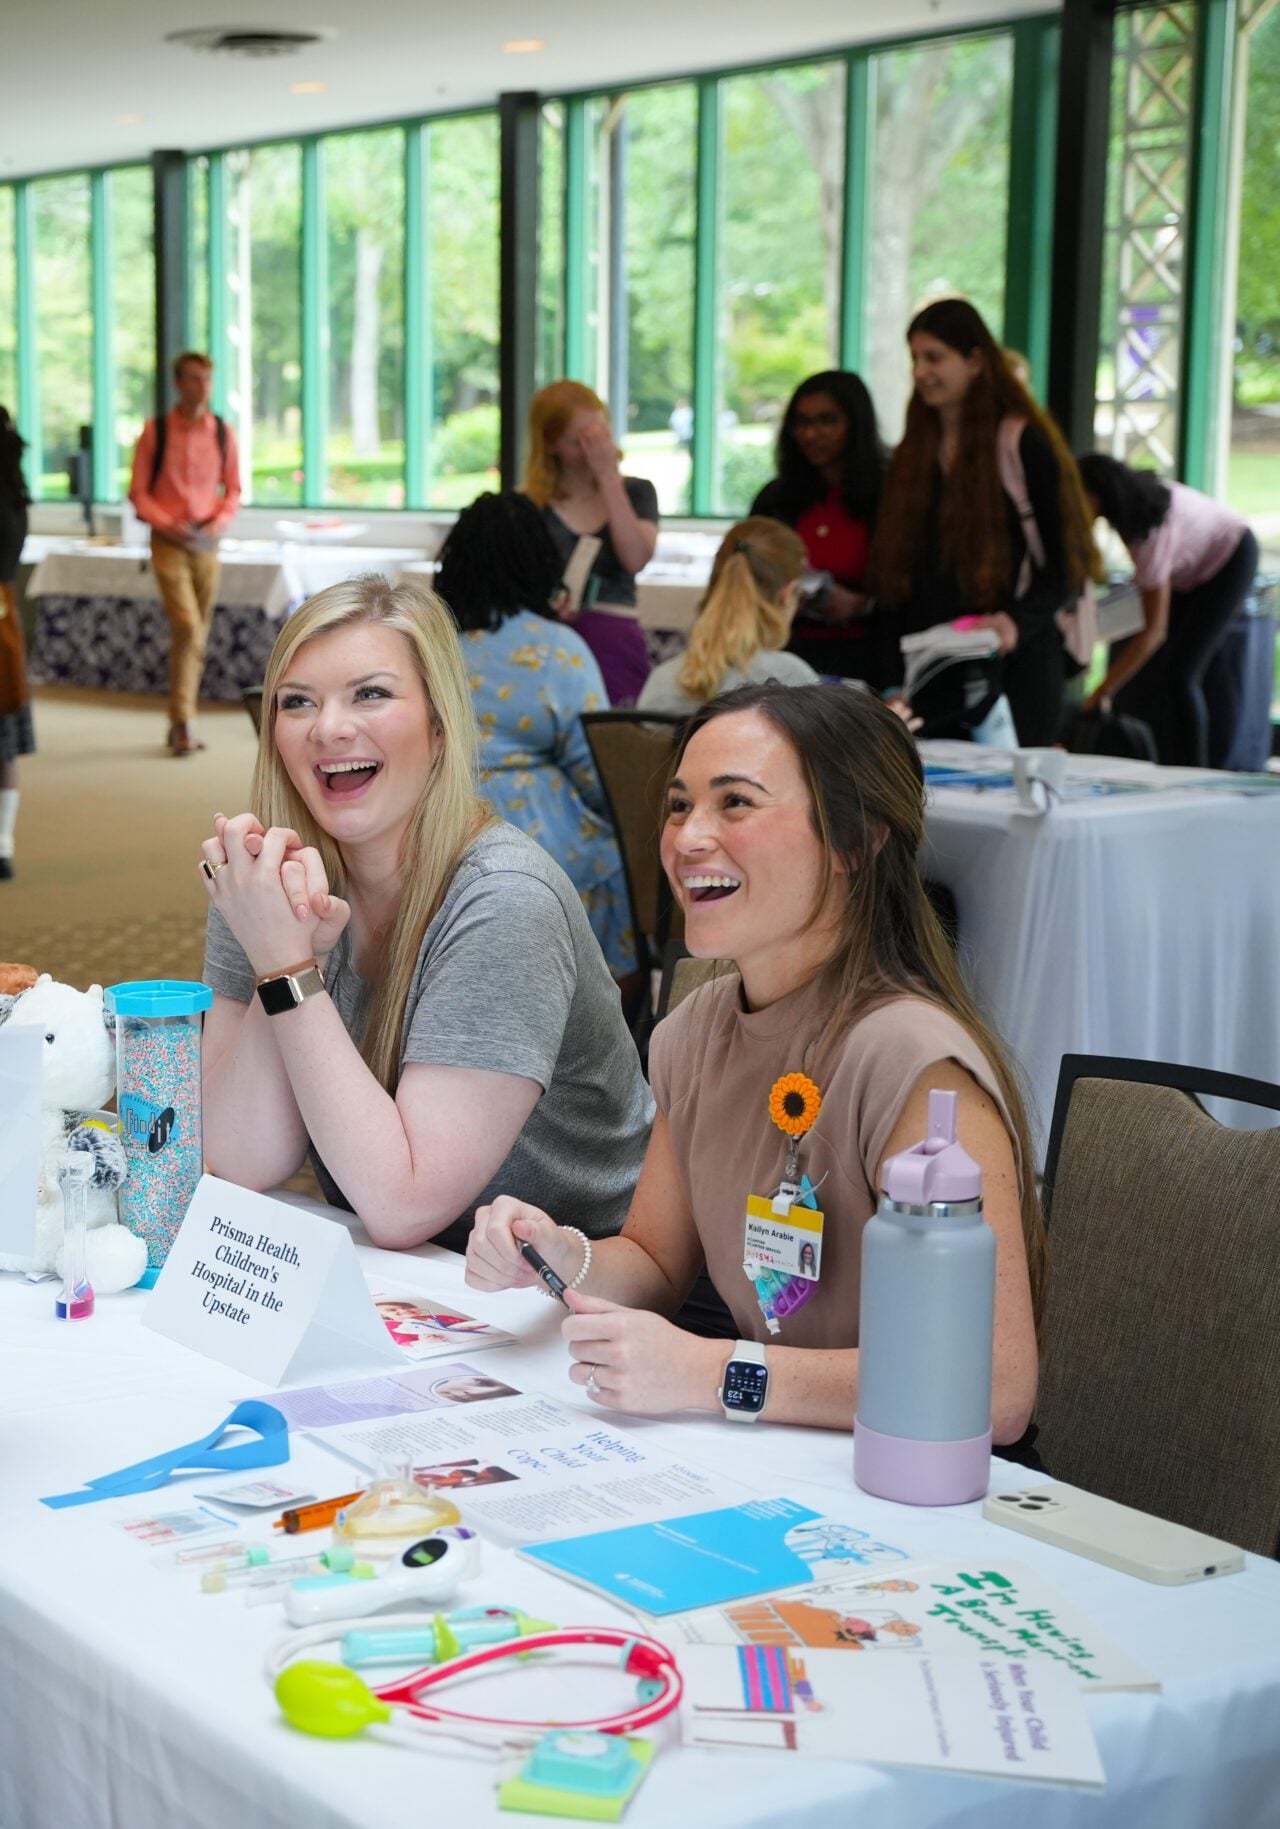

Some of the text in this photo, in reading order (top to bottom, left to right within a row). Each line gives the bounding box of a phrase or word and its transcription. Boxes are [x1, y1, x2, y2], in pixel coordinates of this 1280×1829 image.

[126, 1108, 156, 1135] Find
[209, 1215, 301, 1269] Prisma Health,
[771, 1229, 794, 1242] Arabie
[215, 1244, 280, 1284] Children's
[190, 1260, 283, 1313] Hospital in the
[202, 1291, 250, 1325] Upstate
[539, 1447, 589, 1469] Child
[585, 1431, 647, 1464] Helping
[929, 1583, 1103, 1679] A Bone Marrow
[956, 1571, 1095, 1658] I'm Having
[982, 1669, 1011, 1711] Seriously
[1018, 1689, 1036, 1714] Your
[993, 1714, 1026, 1762] Injured
[1025, 1717, 1052, 1751] Child
